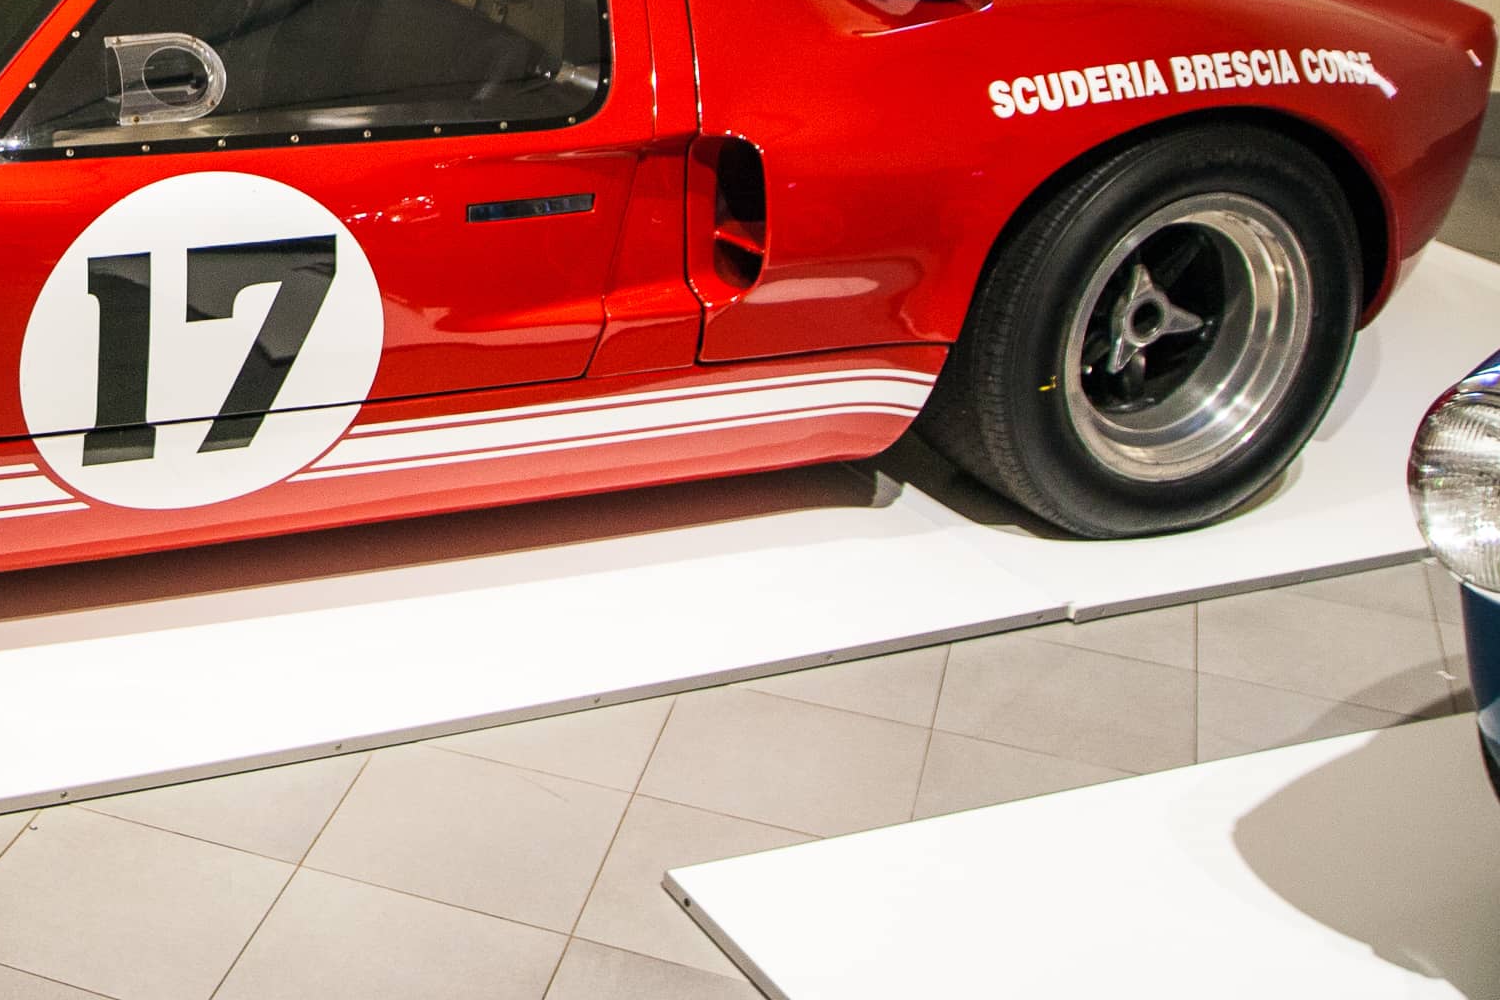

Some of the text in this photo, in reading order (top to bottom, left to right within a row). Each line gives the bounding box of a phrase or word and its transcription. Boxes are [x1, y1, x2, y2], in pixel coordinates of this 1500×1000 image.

[988, 48, 1375, 119] SCUDERIA BRESCIA CORSE
[82, 234, 337, 467] 17
